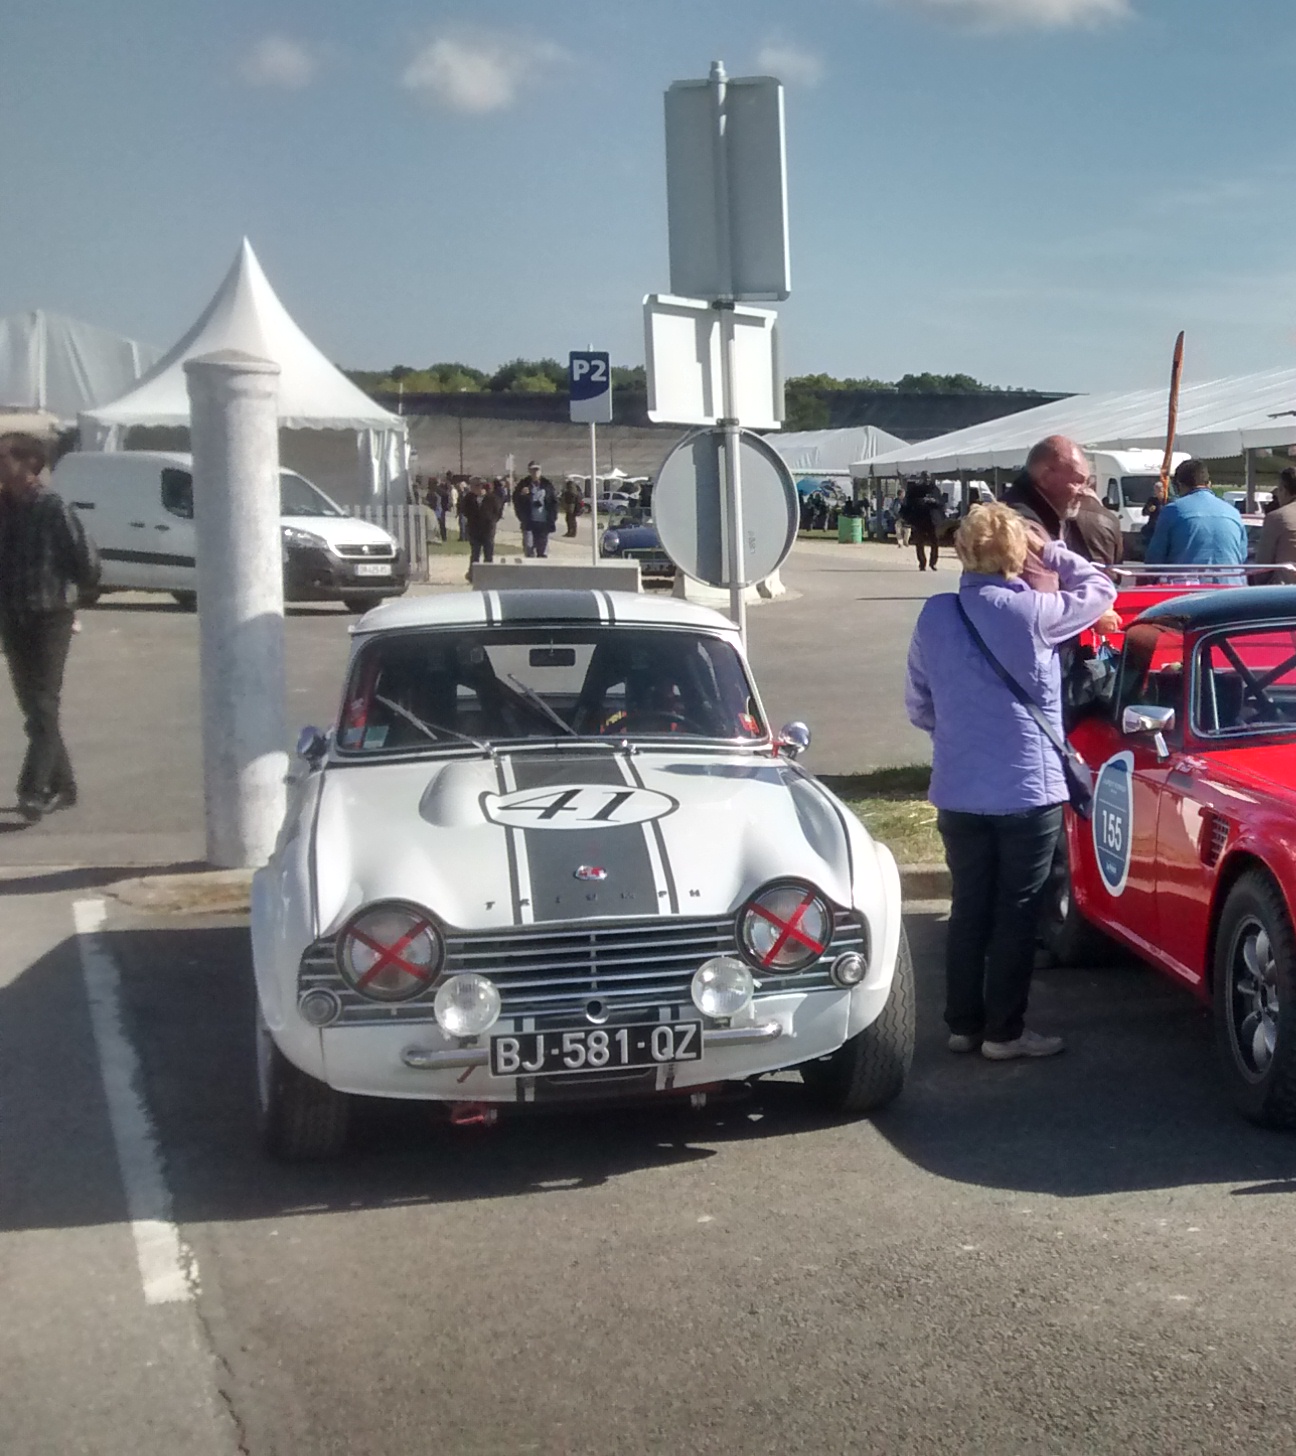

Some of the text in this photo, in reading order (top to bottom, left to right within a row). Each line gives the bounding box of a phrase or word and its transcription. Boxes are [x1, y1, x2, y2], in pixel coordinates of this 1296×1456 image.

[573, 359, 607, 381] P2
[497, 788, 636, 822] 41
[1102, 809, 1122, 851] 155
[496, 1024, 697, 1074] BJ-581-QZ
